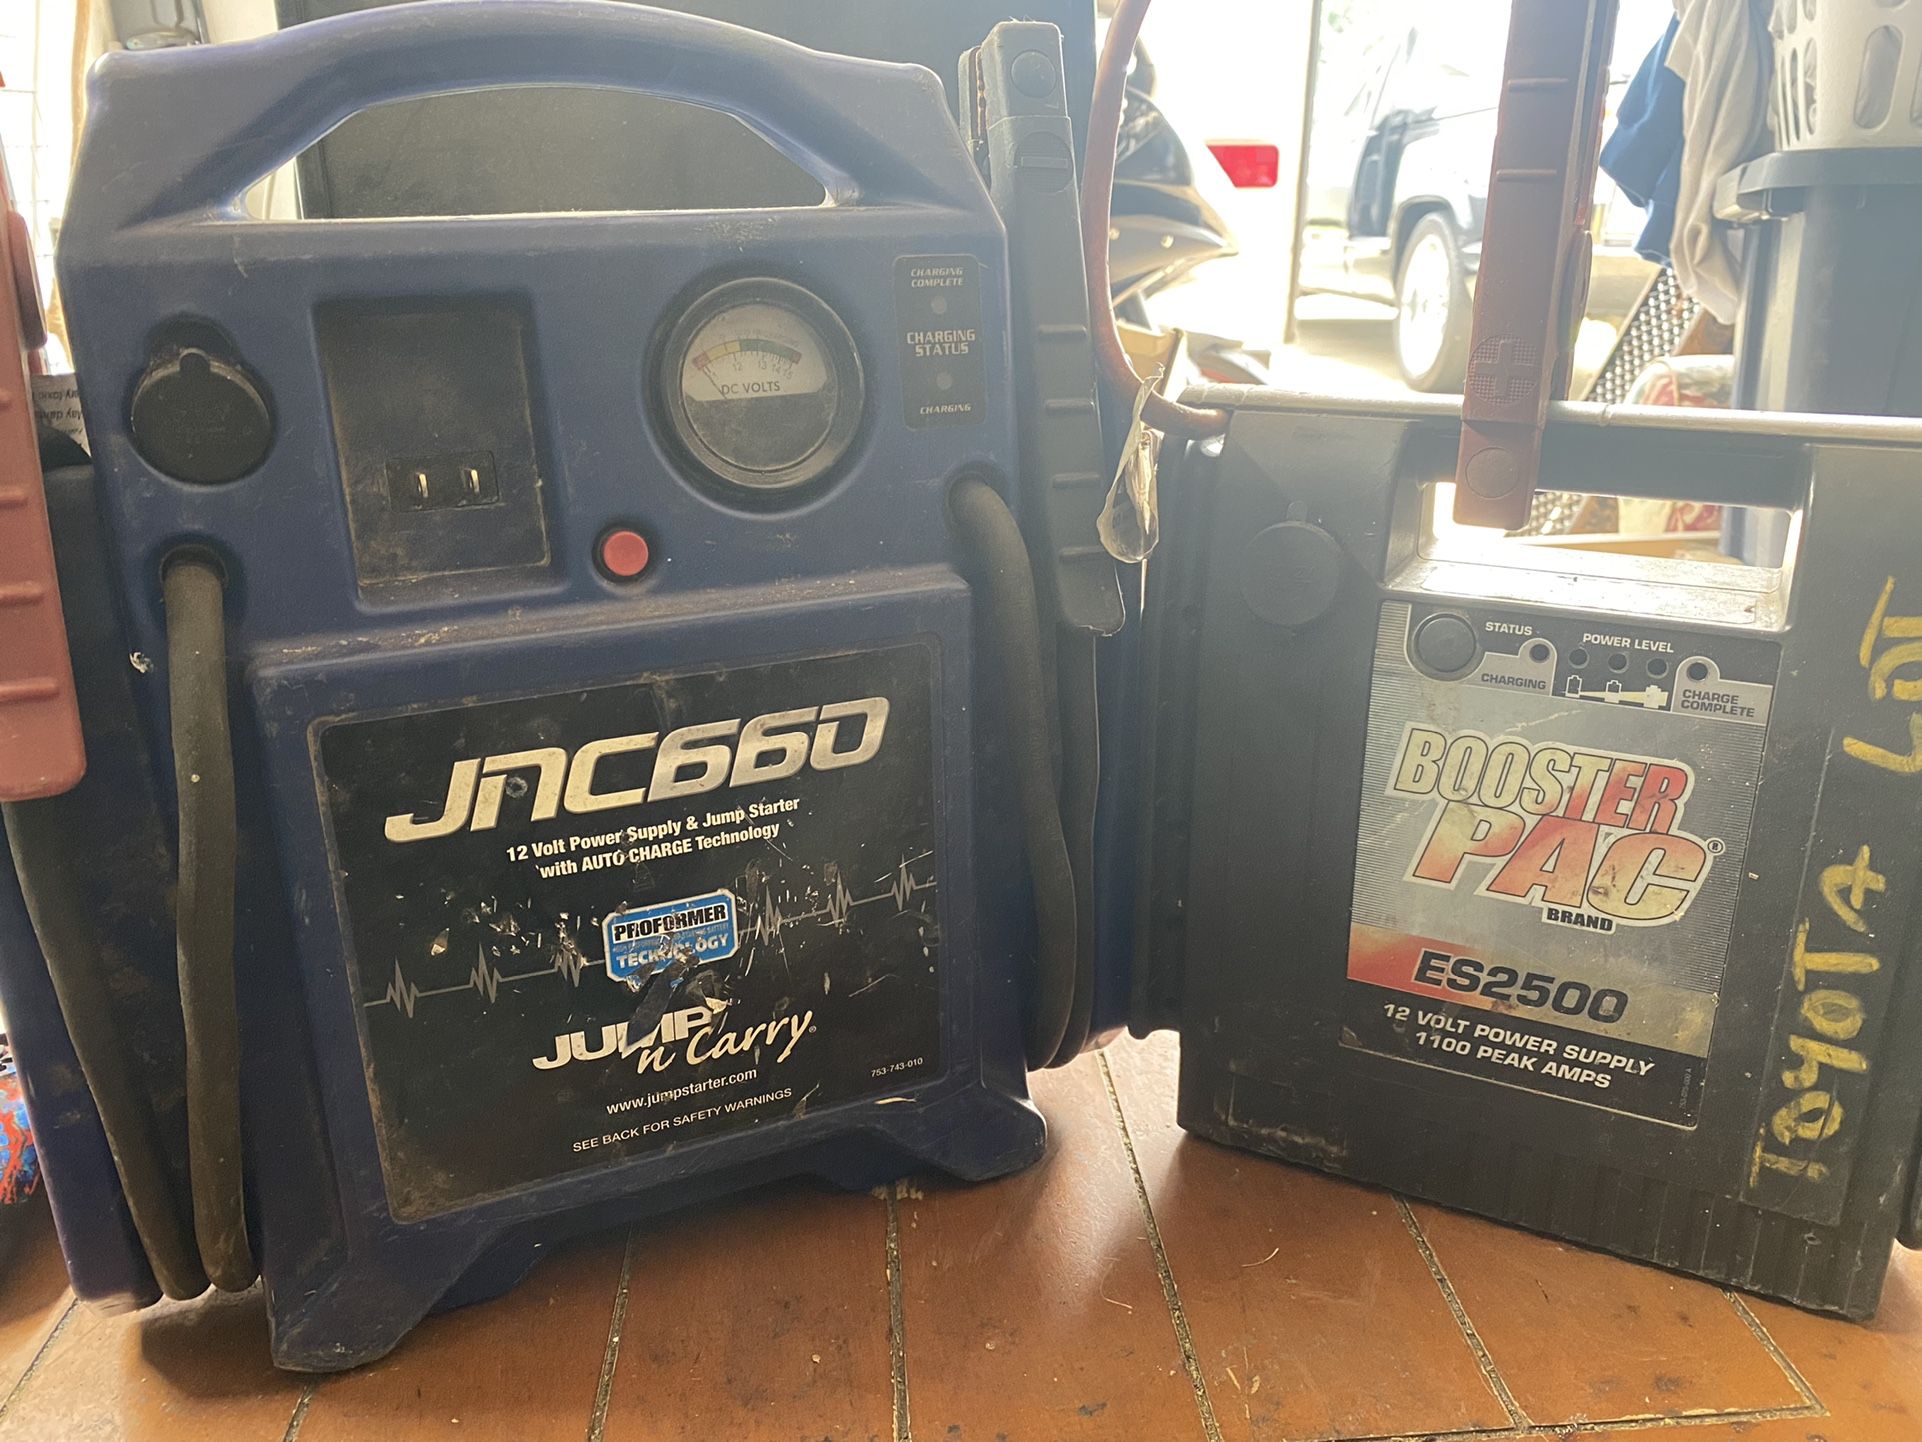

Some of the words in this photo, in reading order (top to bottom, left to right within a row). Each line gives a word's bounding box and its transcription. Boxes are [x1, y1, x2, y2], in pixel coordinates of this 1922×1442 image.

[911, 267, 963, 277] CHARGING
[912, 278, 964, 288] COMPLETE
[907, 329, 976, 344] CHARGING
[915, 342, 969, 357] STATUS
[721, 383, 739, 395] DC
[742, 381, 781, 394] VOLTS
[920, 403, 972, 414] CHARGING
[1485, 621, 1533, 635] STATUS
[1583, 633, 1631, 648] POWER
[1634, 639, 1675, 653] LEVEL
[1481, 673, 1547, 690] CHARGING
[1680, 700, 1755, 717] COMPLETE
[1682, 689, 1740, 705] CHARGE
[1393, 726, 1689, 834] BOOSTER
[507, 845, 529, 863] 12
[531, 841, 566, 859] Volt
[570, 830, 622, 852] Power
[627, 819, 682, 843] Supply
[686, 815, 699, 831] &
[702, 806, 746, 829] Jump
[749, 797, 801, 819] Starter
[538, 859, 579, 880] with
[628, 836, 693, 863] CHARGE
[694, 823, 781, 851] Technology
[1411, 798, 1707, 921] PAC
[614, 904, 727, 941] PROFORMER
[1546, 907, 1614, 932] BRAND
[1412, 950, 1629, 1024] ES2500
[1748, 843, 1888, 1188] TOYOTA
[685, 1010, 814, 1064] Carry
[1384, 1003, 1409, 1021] 12
[1416, 1009, 1471, 1035] VOLT
[1473, 1023, 1559, 1055] POWER
[1563, 1043, 1656, 1077] SUPPLY
[871, 1056, 924, 1078] 753-743-010
[1415, 1031, 1472, 1056] 1100
[1476, 1045, 1540, 1072] PEAK
[1541, 1061, 1614, 1090] AMPS
[605, 1067, 758, 1116] www.jumpstarter.com
[573, 1137, 600, 1153] SEE
[602, 1127, 641, 1146] BACK
[642, 1119, 671, 1136] FOR
[672, 1105, 723, 1128] SAFETY
[724, 1087, 794, 1114] WARNINGS
